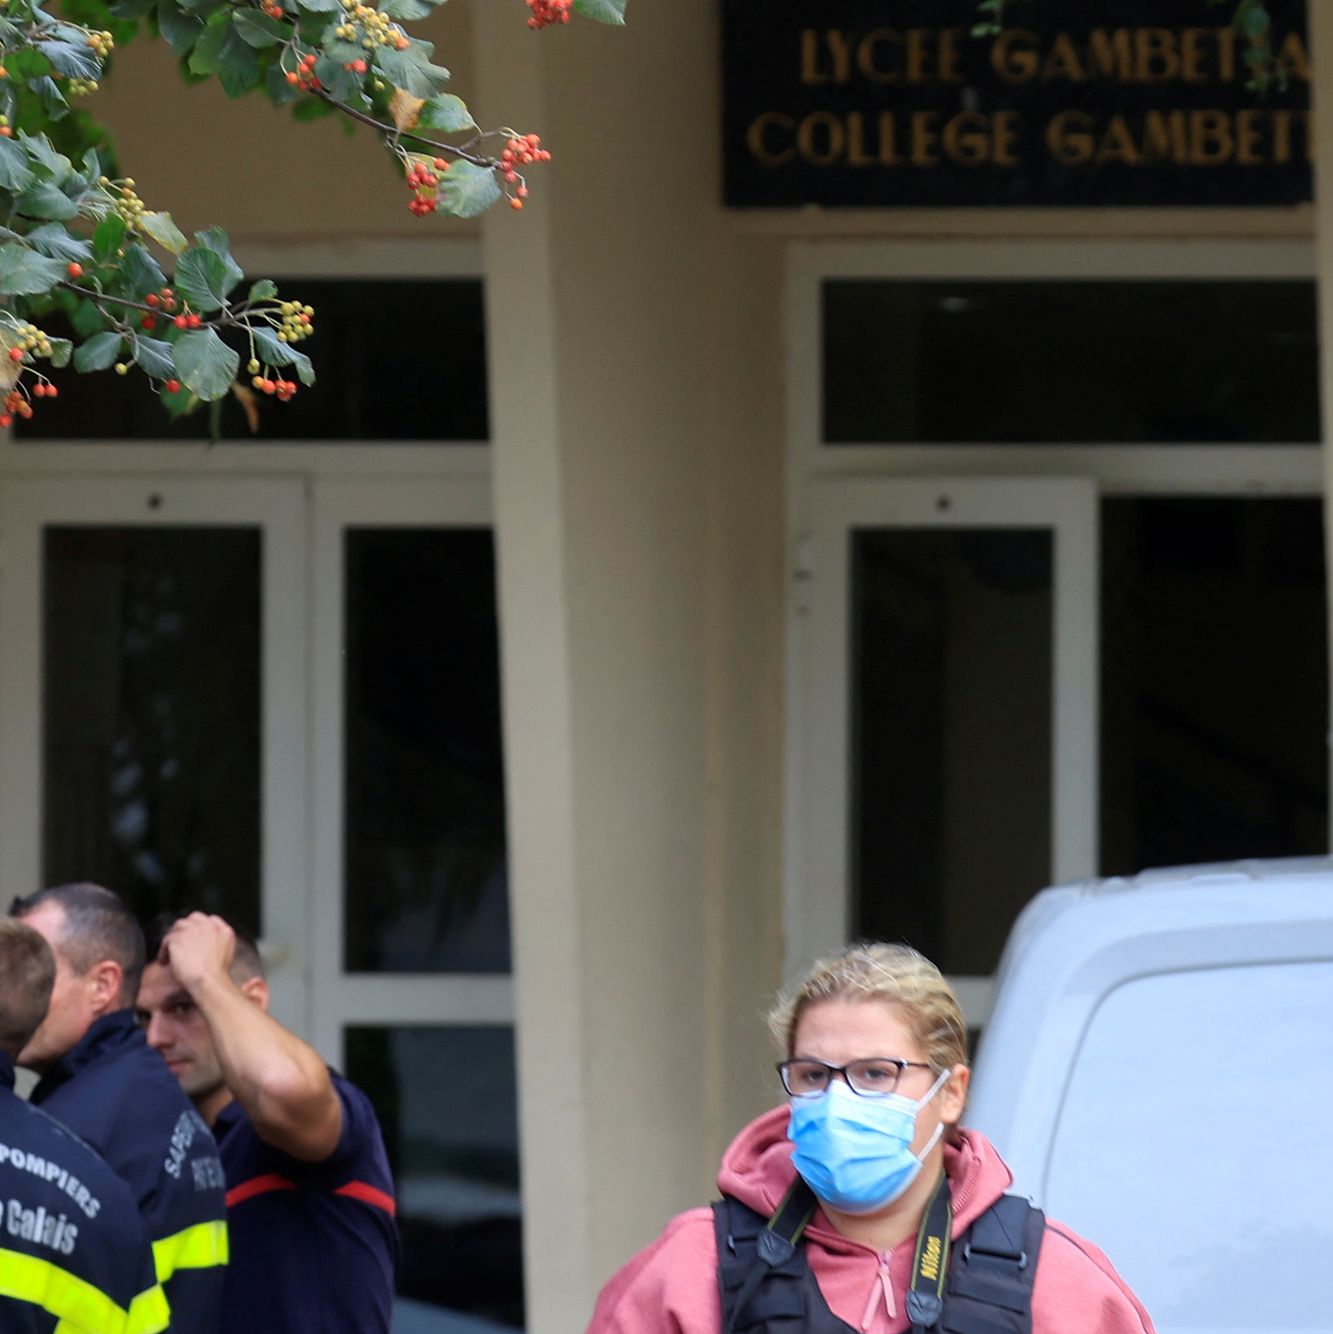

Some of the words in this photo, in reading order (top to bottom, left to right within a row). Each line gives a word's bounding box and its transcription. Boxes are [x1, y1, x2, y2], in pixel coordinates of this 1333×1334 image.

[990, 27, 1314, 85] GAMBETA
[6, 1197, 79, 1256] Calais
[920, 1235, 942, 1281] Nikon
